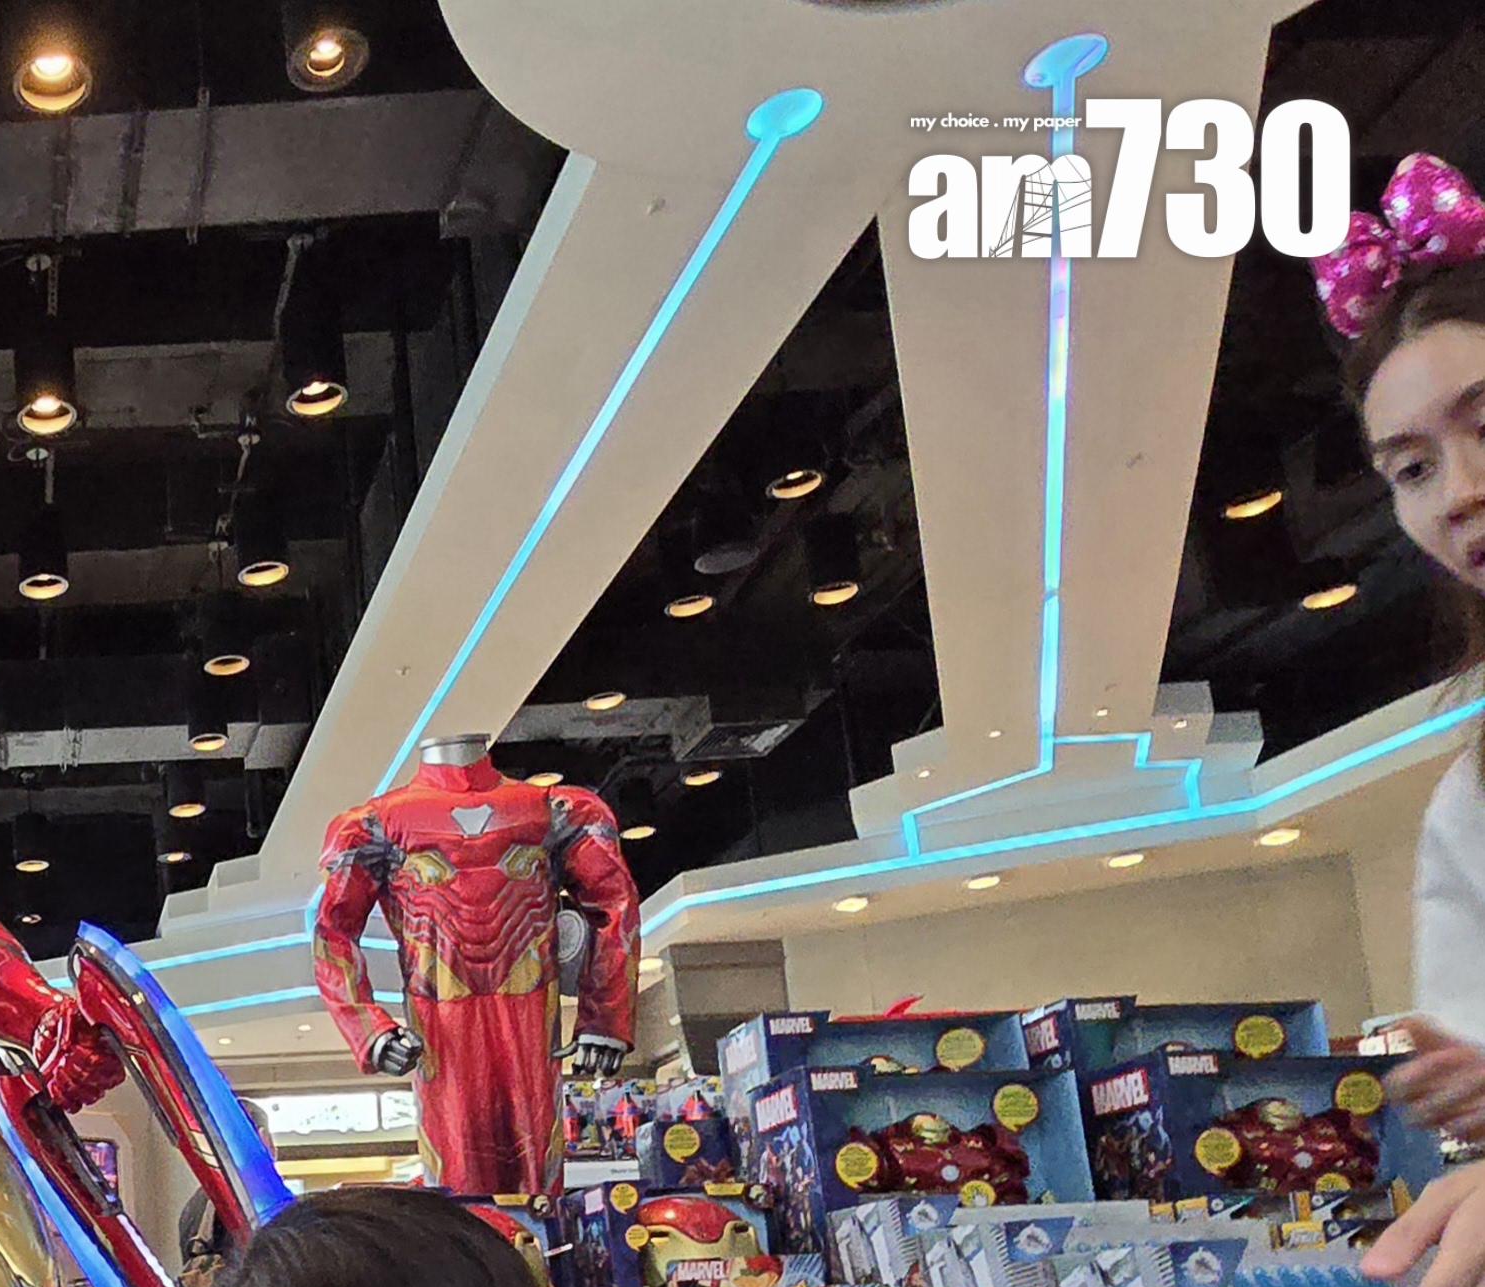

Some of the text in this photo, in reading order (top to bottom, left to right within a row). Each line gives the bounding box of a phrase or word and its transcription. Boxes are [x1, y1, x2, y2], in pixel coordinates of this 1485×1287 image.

[769, 1016, 814, 1036] MARVEL
[1167, 1055, 1219, 1076] MARVEL
[810, 1072, 859, 1092] MARVEL
[1091, 1069, 1150, 1116] MARVEL
[677, 1260, 729, 1282] MARVEL
